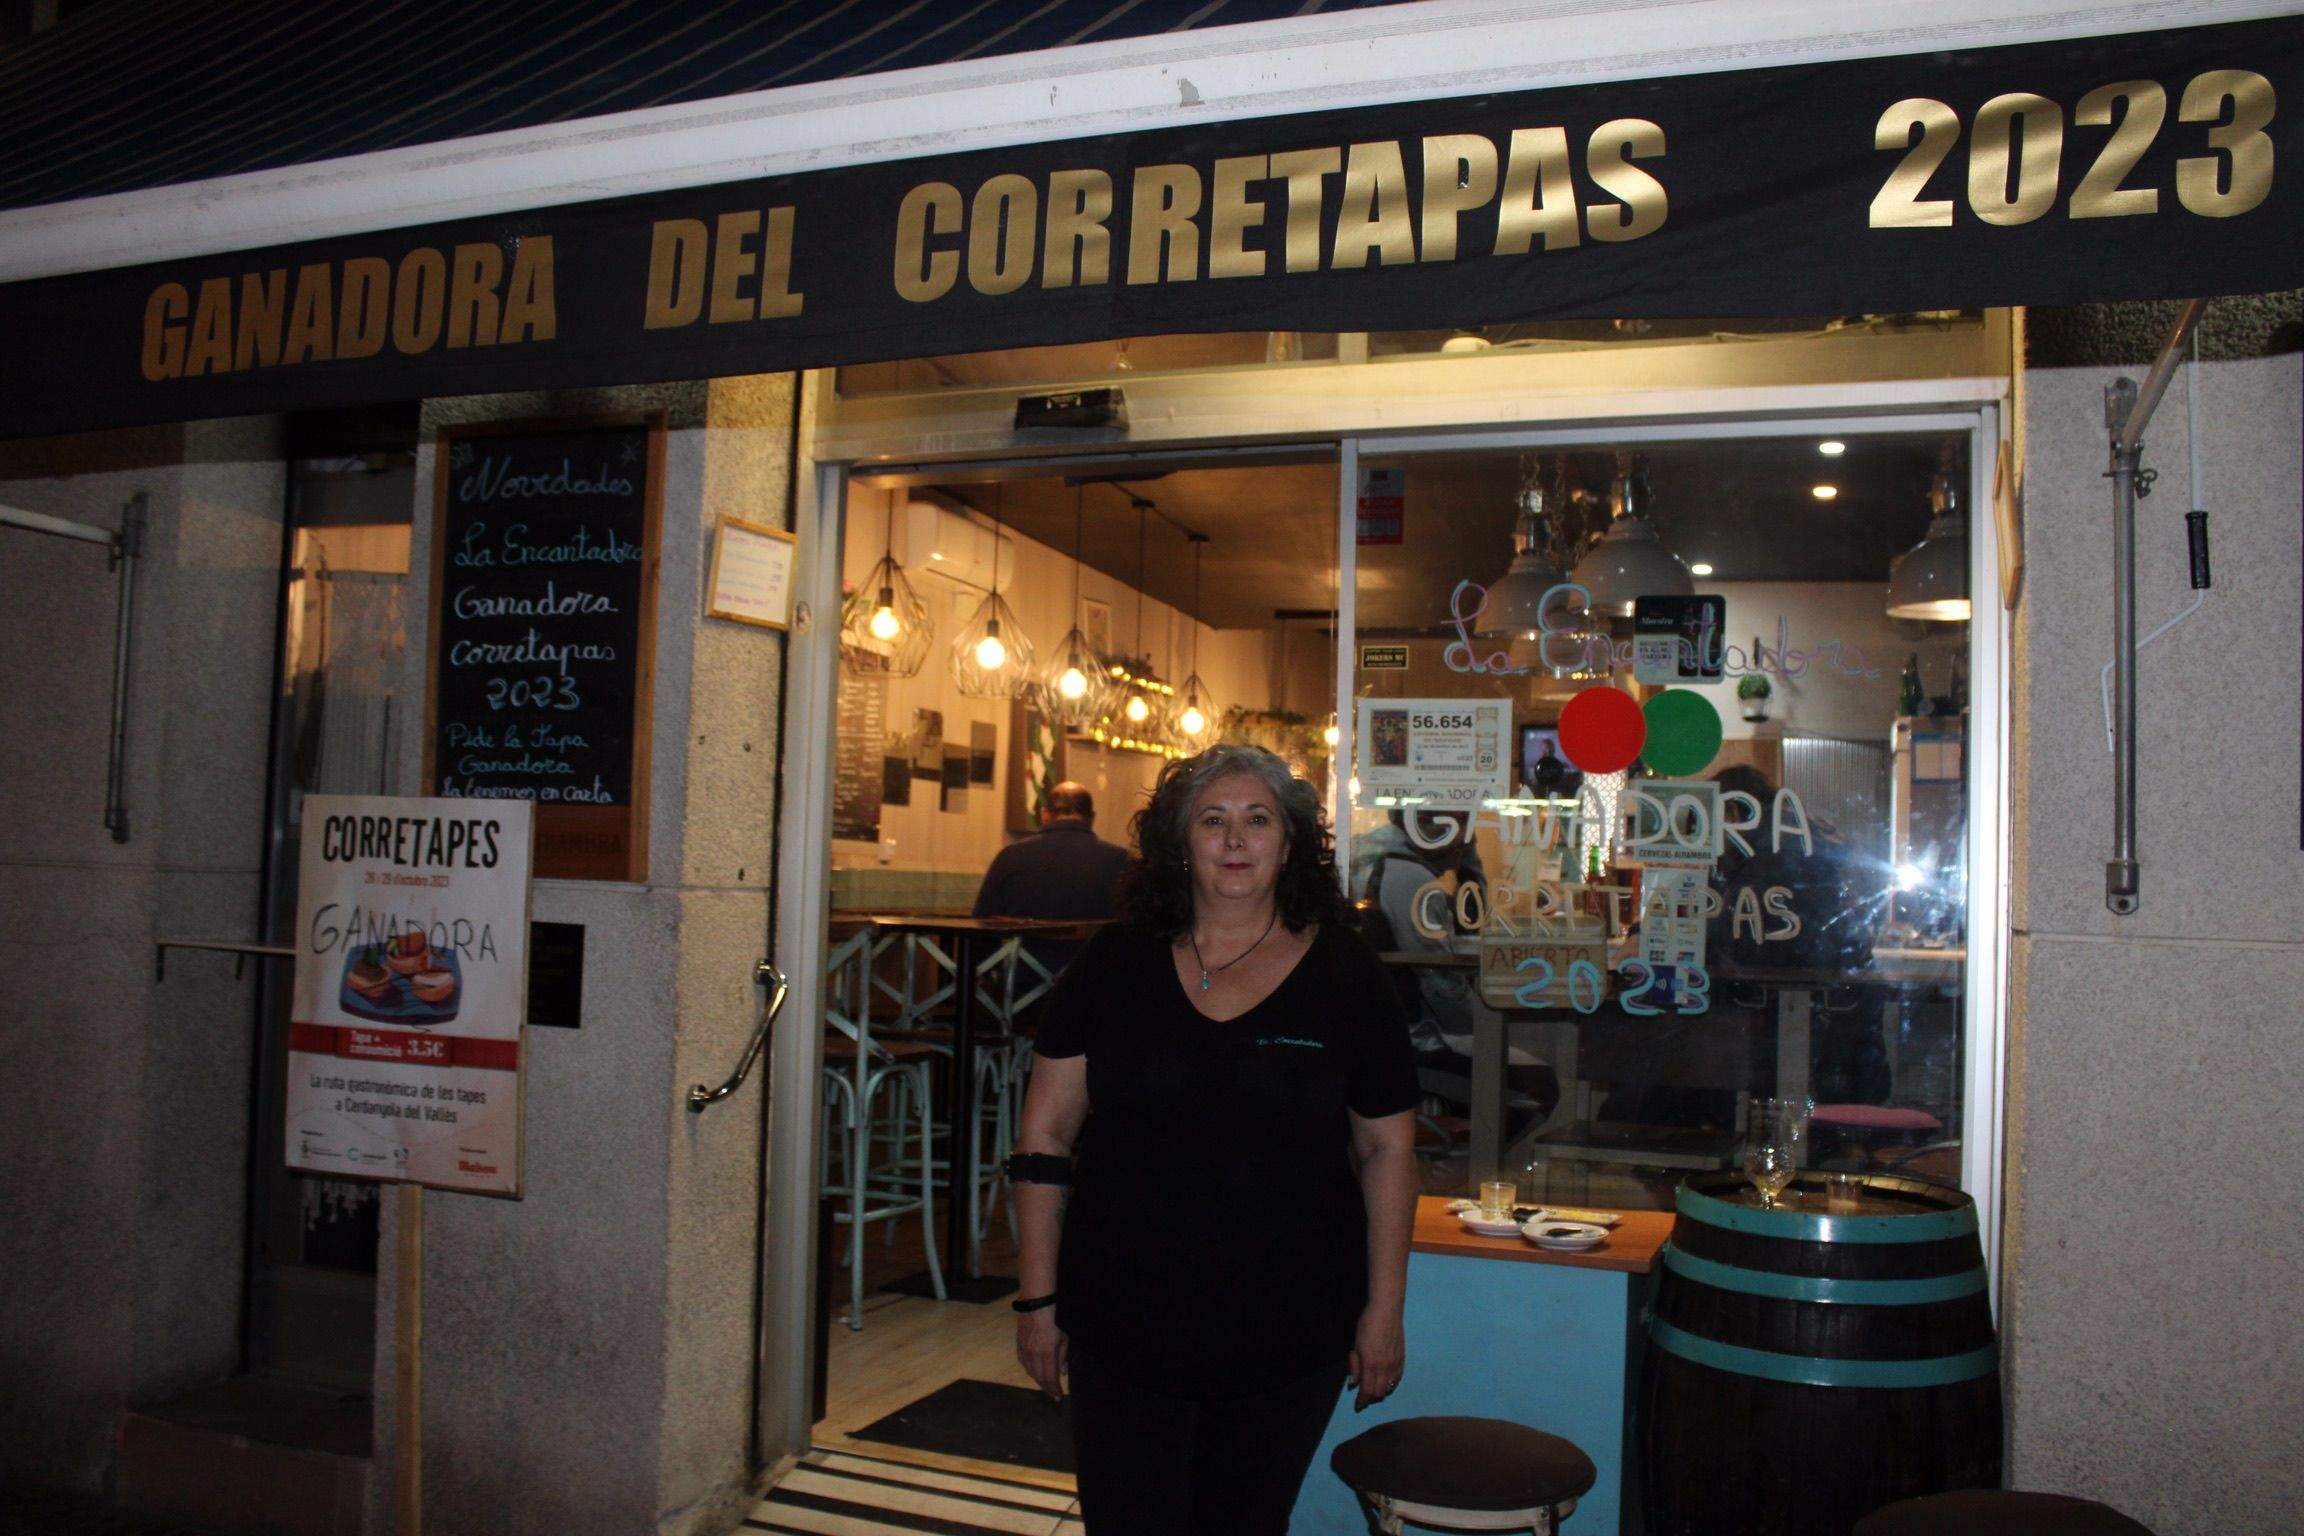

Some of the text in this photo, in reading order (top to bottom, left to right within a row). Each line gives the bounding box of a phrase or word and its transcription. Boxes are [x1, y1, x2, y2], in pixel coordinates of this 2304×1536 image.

[141, 69, 2277, 382] GANADORA DEL CORRETAPAS 2023
[454, 521, 497, 567] La
[454, 580, 618, 619] Ganadora
[1441, 579, 1529, 676] La
[485, 676, 581, 711] 2023
[1412, 715, 1473, 728] 56.654
[458, 753, 575, 775] Ganadora
[541, 785, 560, 800] en
[322, 815, 500, 868] CORRETAPES
[1403, 785, 1813, 859] GANADORA
[311, 903, 499, 963] GANADORA
[1513, 956, 1711, 1016] 2023
